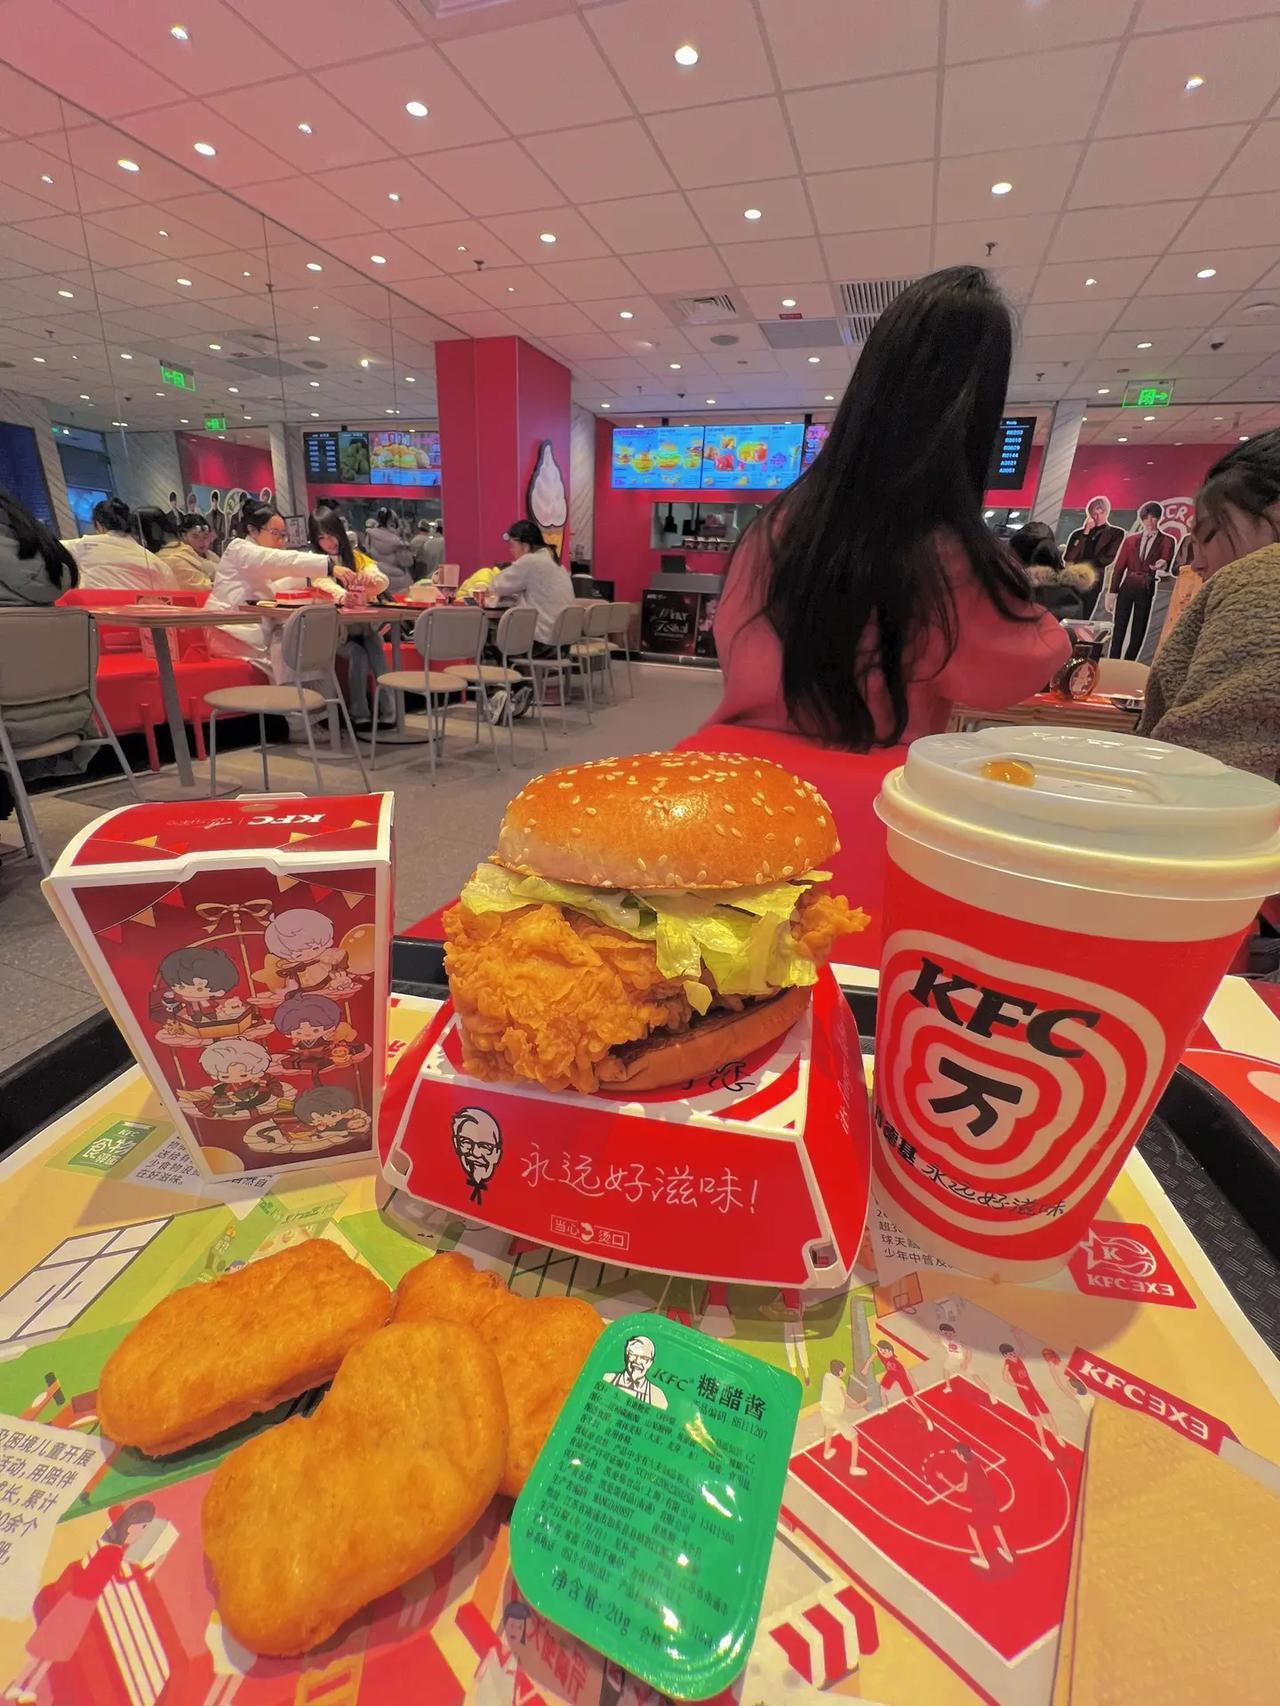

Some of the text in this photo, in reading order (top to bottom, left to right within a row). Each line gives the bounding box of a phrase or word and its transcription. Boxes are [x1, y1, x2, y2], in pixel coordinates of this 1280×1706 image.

[247, 813, 327, 826] KFC
[908, 957, 1101, 1059] KFC
[921, 1163, 1066, 1217] 永远好滋味
[554, 1218, 626, 1248] 当心 烫口
[652, 1367, 690, 1392] KFC
[697, 1373, 767, 1422] 糖醋酱
[0, 1480, 59, 1514] 长,累计
